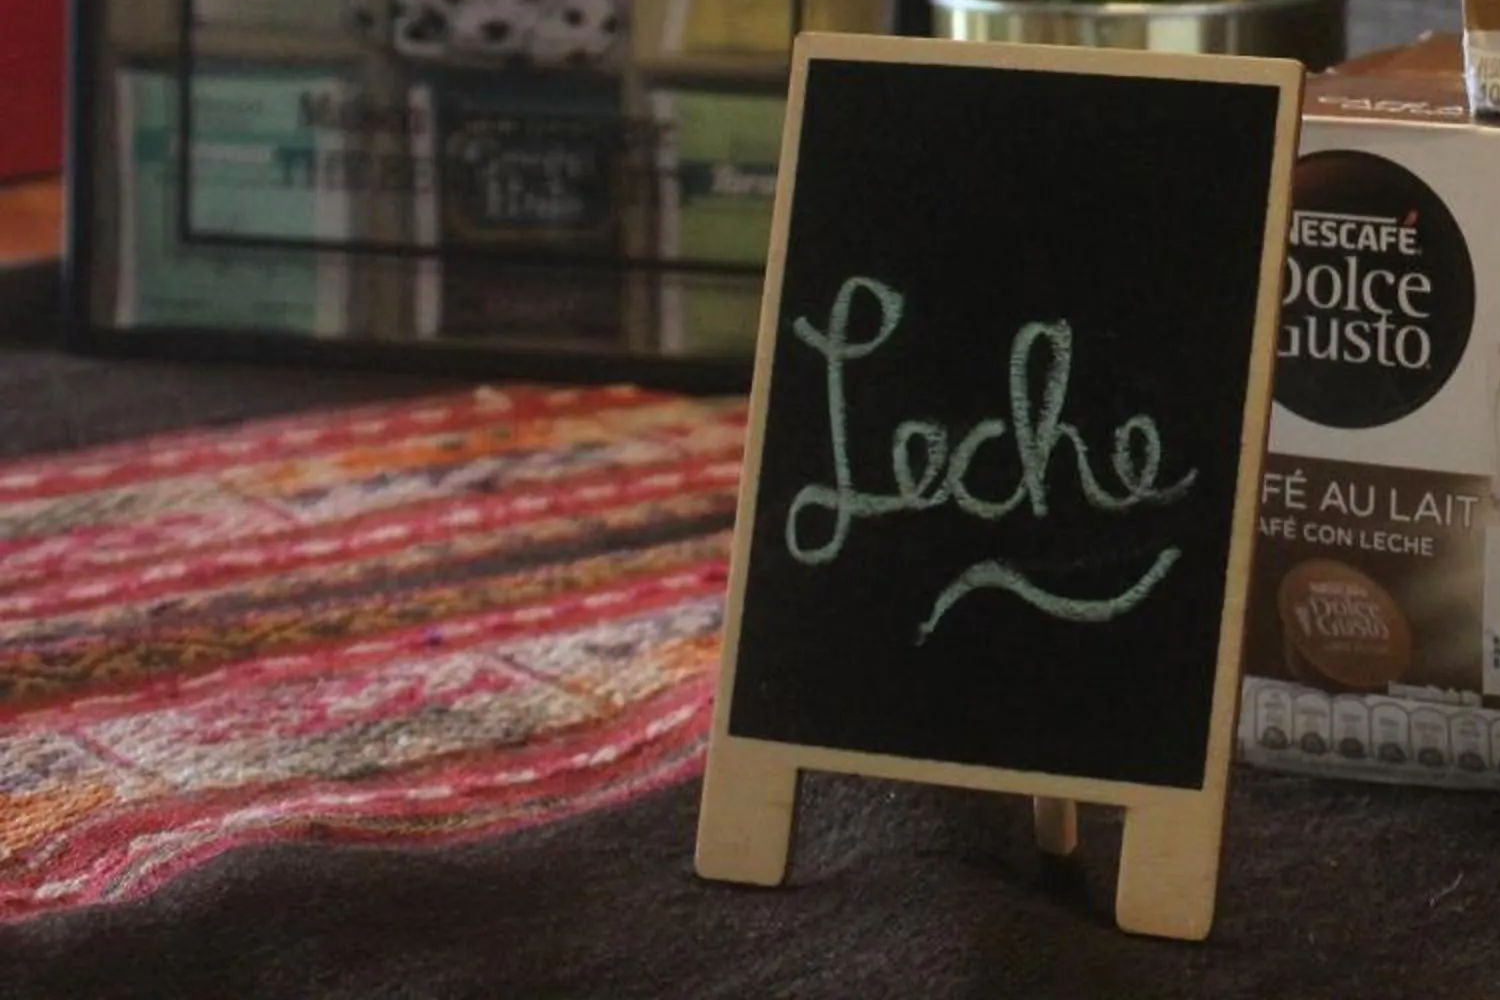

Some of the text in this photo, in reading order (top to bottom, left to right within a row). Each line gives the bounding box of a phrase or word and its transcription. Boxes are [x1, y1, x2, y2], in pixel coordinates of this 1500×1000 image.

[785, 276, 1198, 564] Leche
[1261, 468, 1480, 529] FÉ AU LAIT
[1259, 515, 1435, 558] AFÉ CON LECHE
